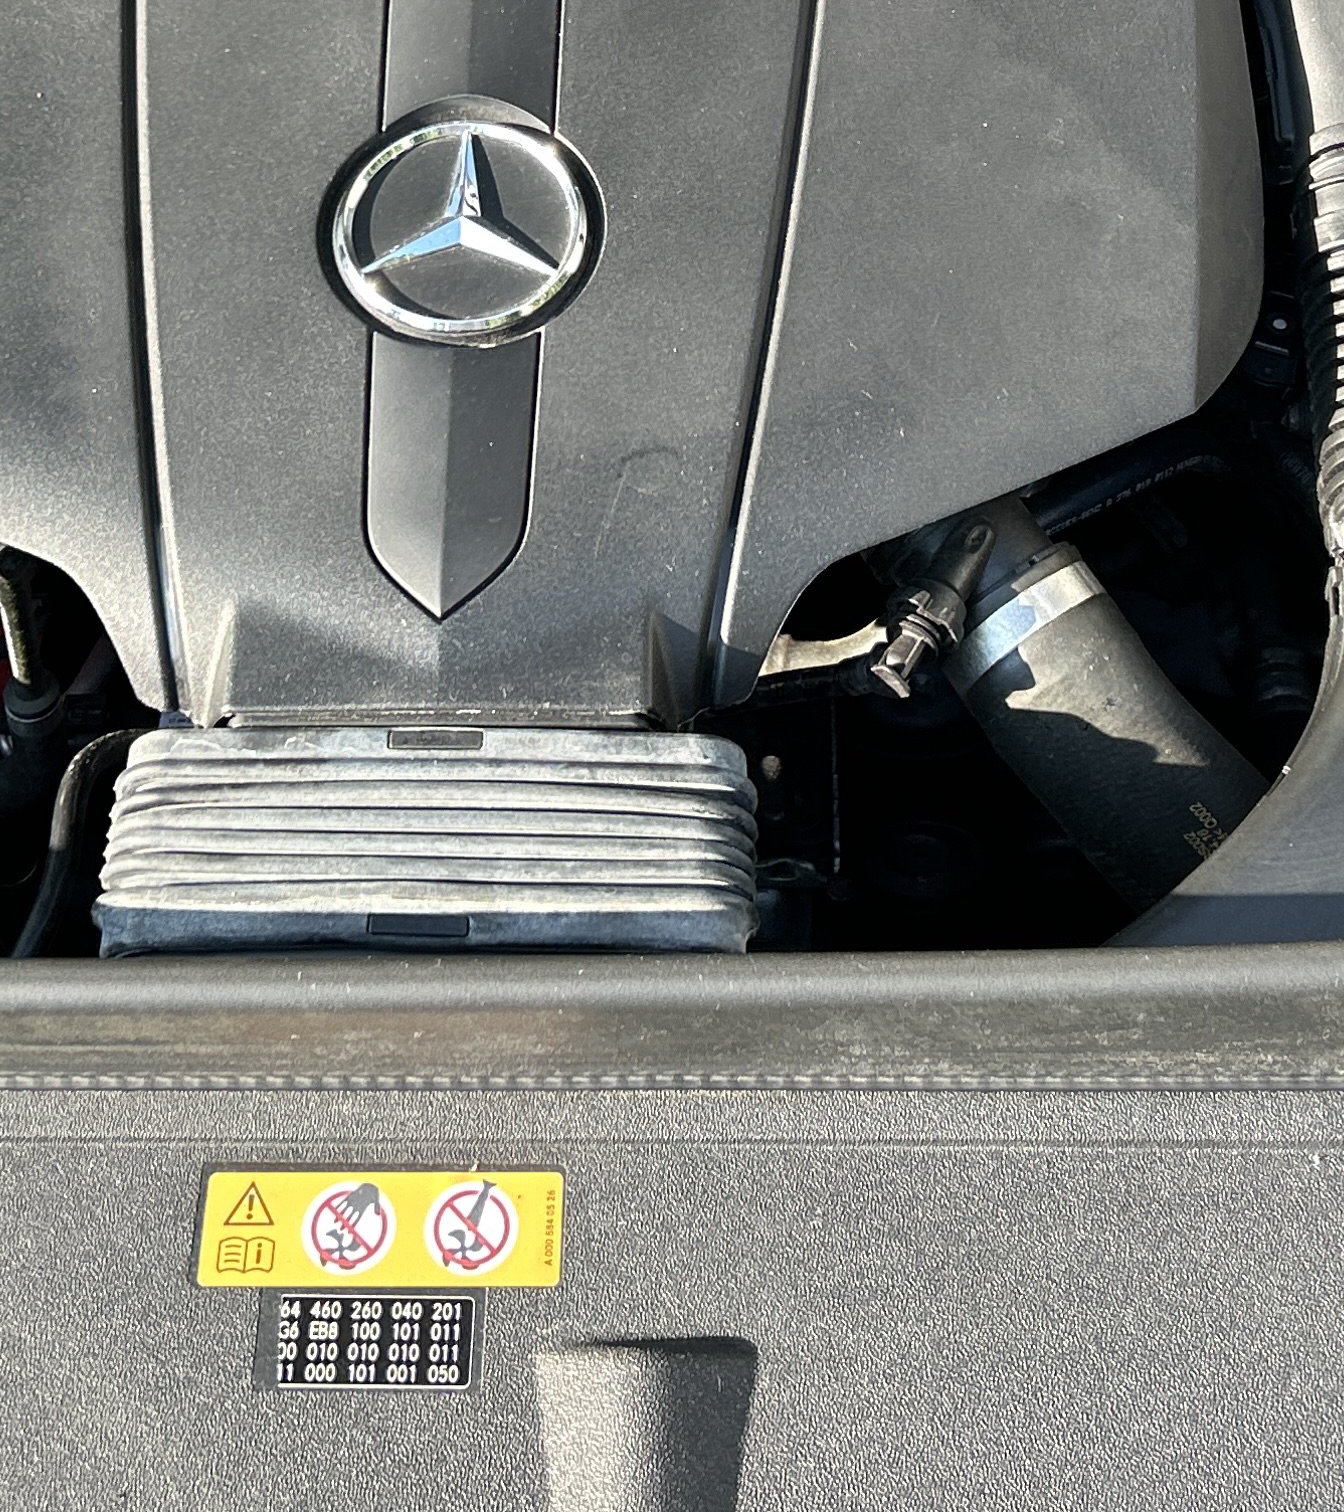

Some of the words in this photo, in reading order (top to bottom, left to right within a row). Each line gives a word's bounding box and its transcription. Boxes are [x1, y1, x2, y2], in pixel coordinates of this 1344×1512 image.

[309, 1300, 342, 1319] 460
[350, 1300, 382, 1320] 260
[391, 1301, 423, 1320] 040
[431, 1302, 462, 1321] 201
[308, 1320, 339, 1340] EB8
[351, 1321, 381, 1341] 100
[392, 1322, 421, 1341] 101
[430, 1322, 461, 1342] 011
[306, 1342, 339, 1361] 010
[347, 1342, 380, 1362] 010
[388, 1343, 420, 1362] 010
[429, 1343, 459, 1363] 011
[304, 1362, 337, 1382] 000
[348, 1363, 376, 1383] 101
[386, 1364, 417, 1384] 001
[427, 1364, 460, 1384] 050
